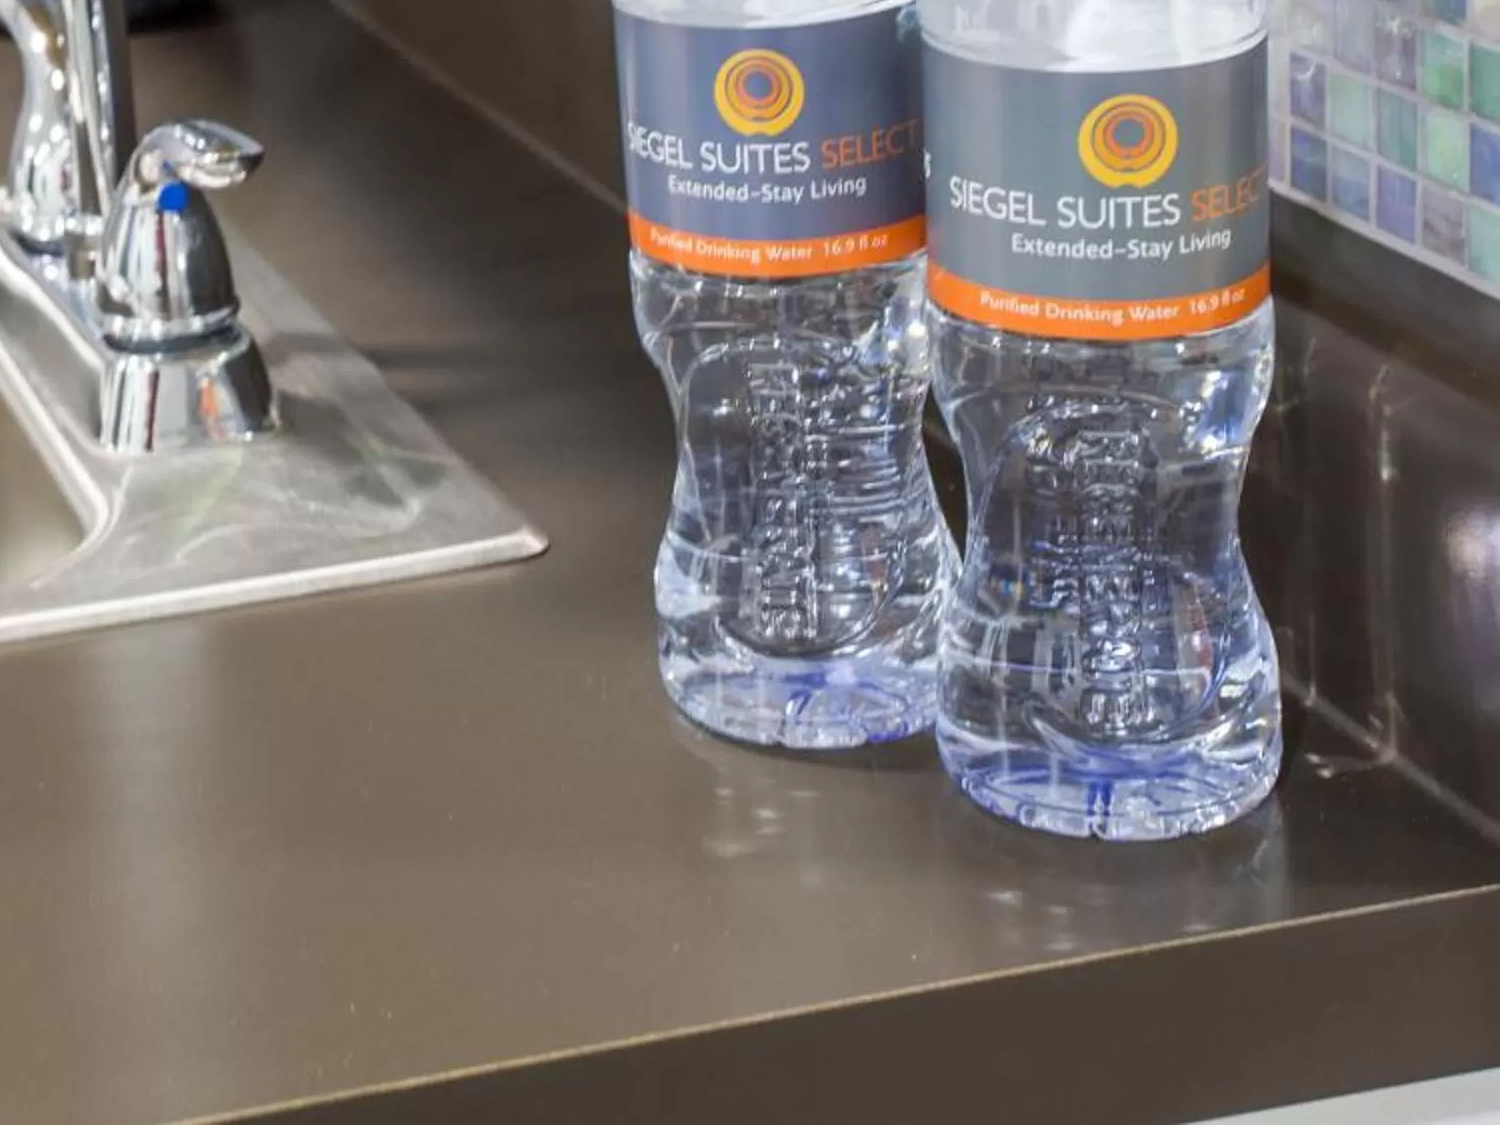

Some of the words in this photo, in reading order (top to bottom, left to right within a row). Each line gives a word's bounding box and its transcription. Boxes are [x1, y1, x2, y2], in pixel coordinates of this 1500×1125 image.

[699, 140, 811, 174] SUITES
[667, 174, 803, 205] Extended-Stay
[811, 175, 867, 199] Living
[949, 175, 1047, 227] SIEGEL
[1057, 194, 1181, 229] SUITES
[696, 236, 761, 264] Drinking
[765, 244, 813, 262] Water
[824, 236, 855, 259] 16.9
[1011, 233, 1172, 260] Extended-Stay
[1179, 228, 1232, 254] Living
[980, 290, 1039, 316] Purified
[1045, 302, 1125, 326] Drinking
[1128, 305, 1179, 323] Water
[1189, 295, 1219, 315] 16.9
